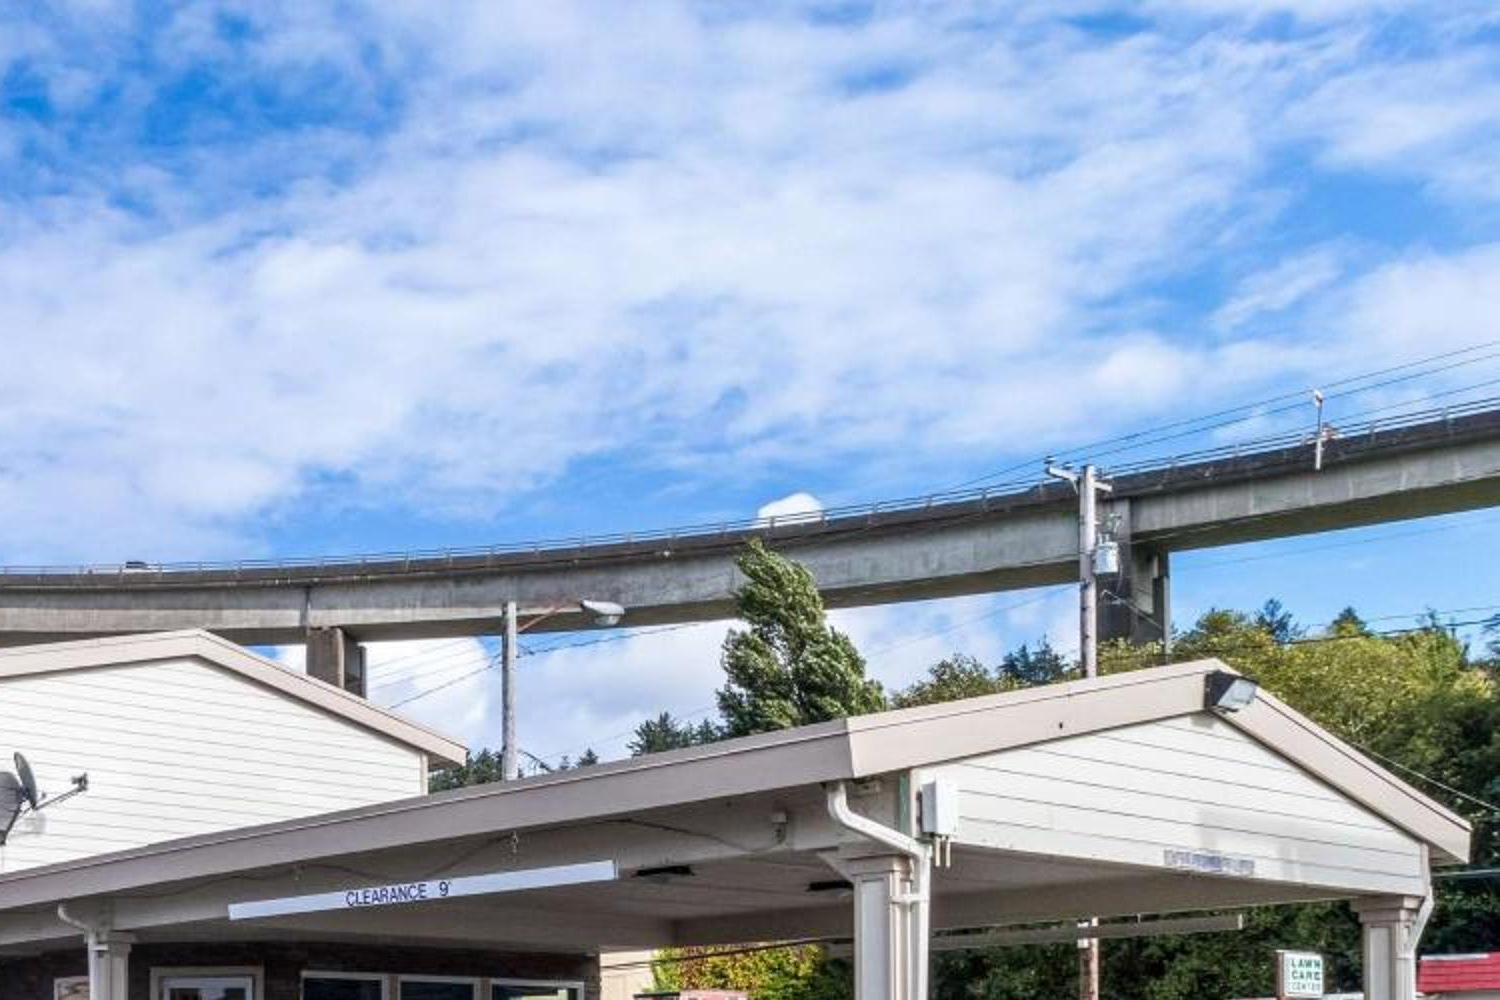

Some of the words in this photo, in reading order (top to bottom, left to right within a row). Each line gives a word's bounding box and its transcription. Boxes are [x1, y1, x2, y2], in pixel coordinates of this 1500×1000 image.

[345, 883, 427, 906] CLEARANCE
[1291, 959, 1321, 969] LAWN
[1291, 970, 1321, 980] CARE
